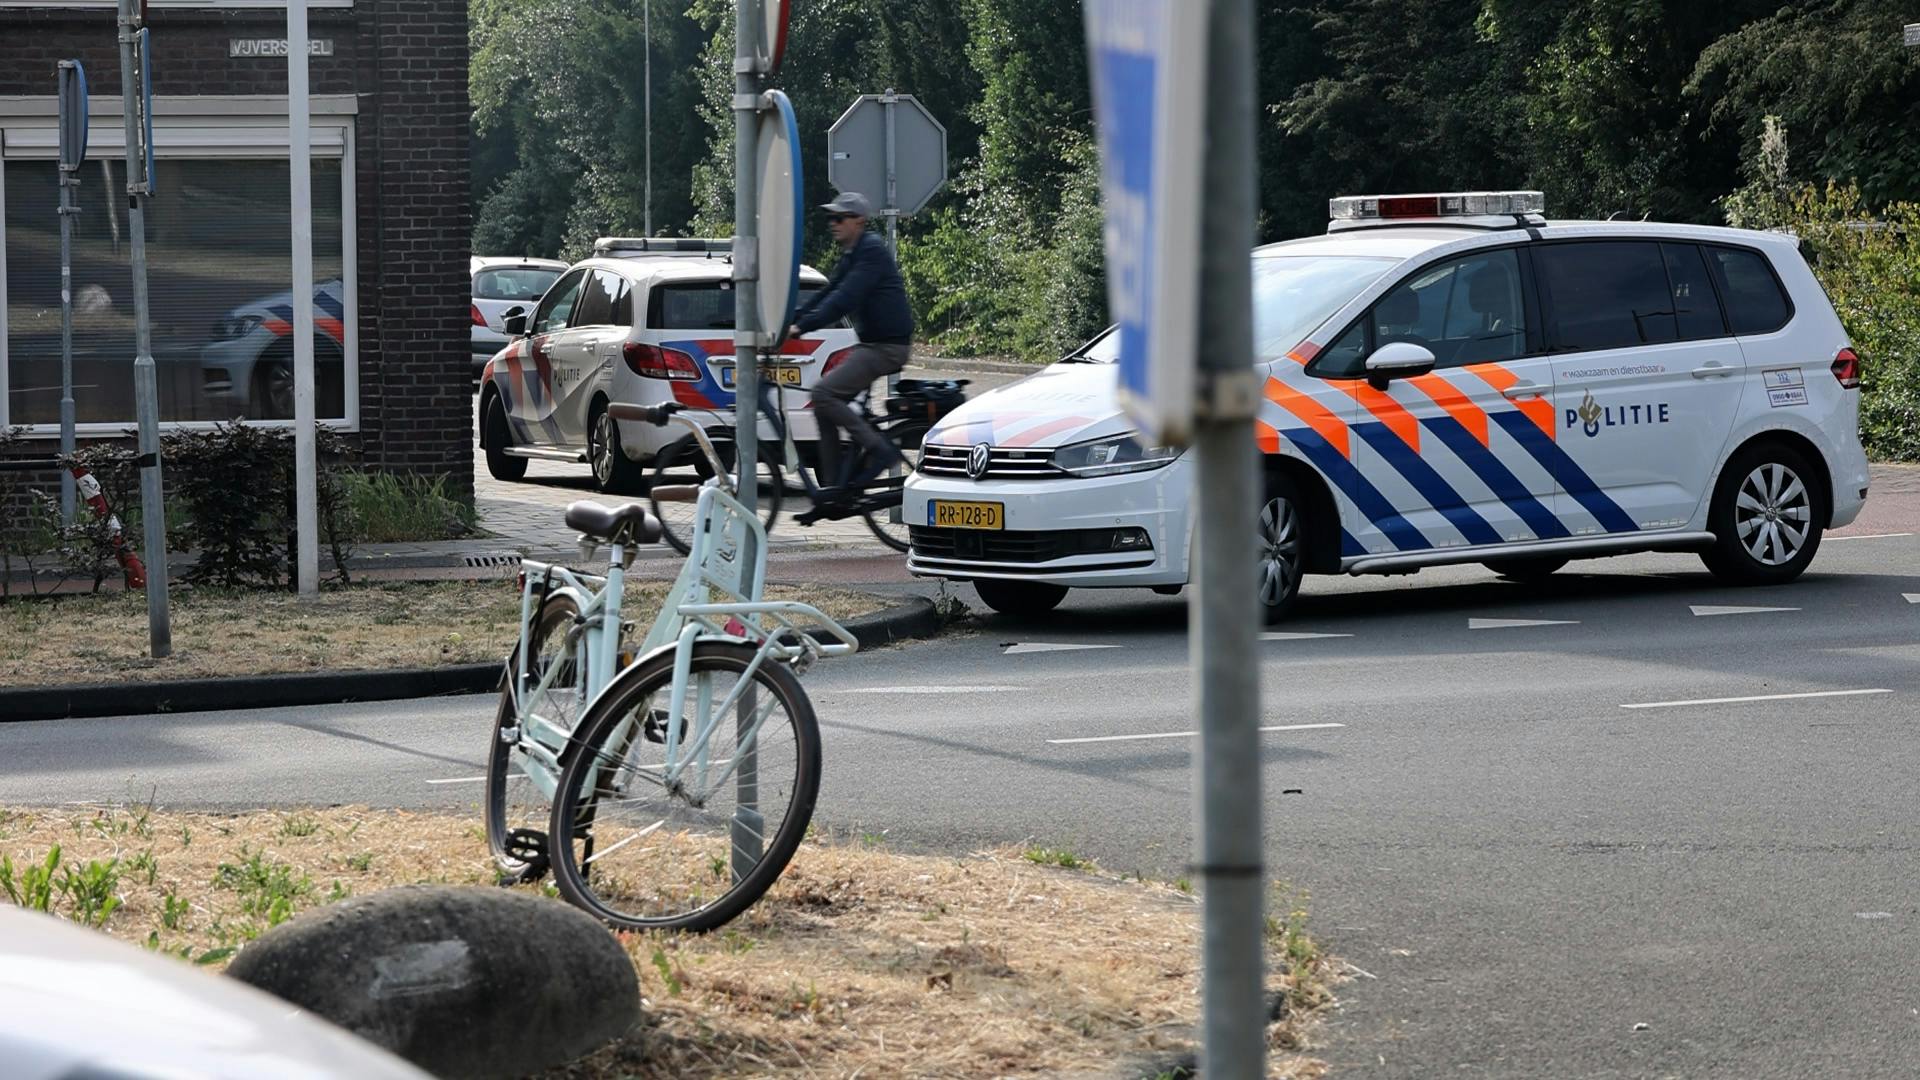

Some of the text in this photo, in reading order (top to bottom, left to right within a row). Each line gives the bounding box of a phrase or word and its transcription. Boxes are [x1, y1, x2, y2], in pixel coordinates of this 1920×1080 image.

[1610, 368, 1620, 376] en
[1566, 404, 1669, 437] POLITIE
[939, 505, 996, 525] RR-128-D
